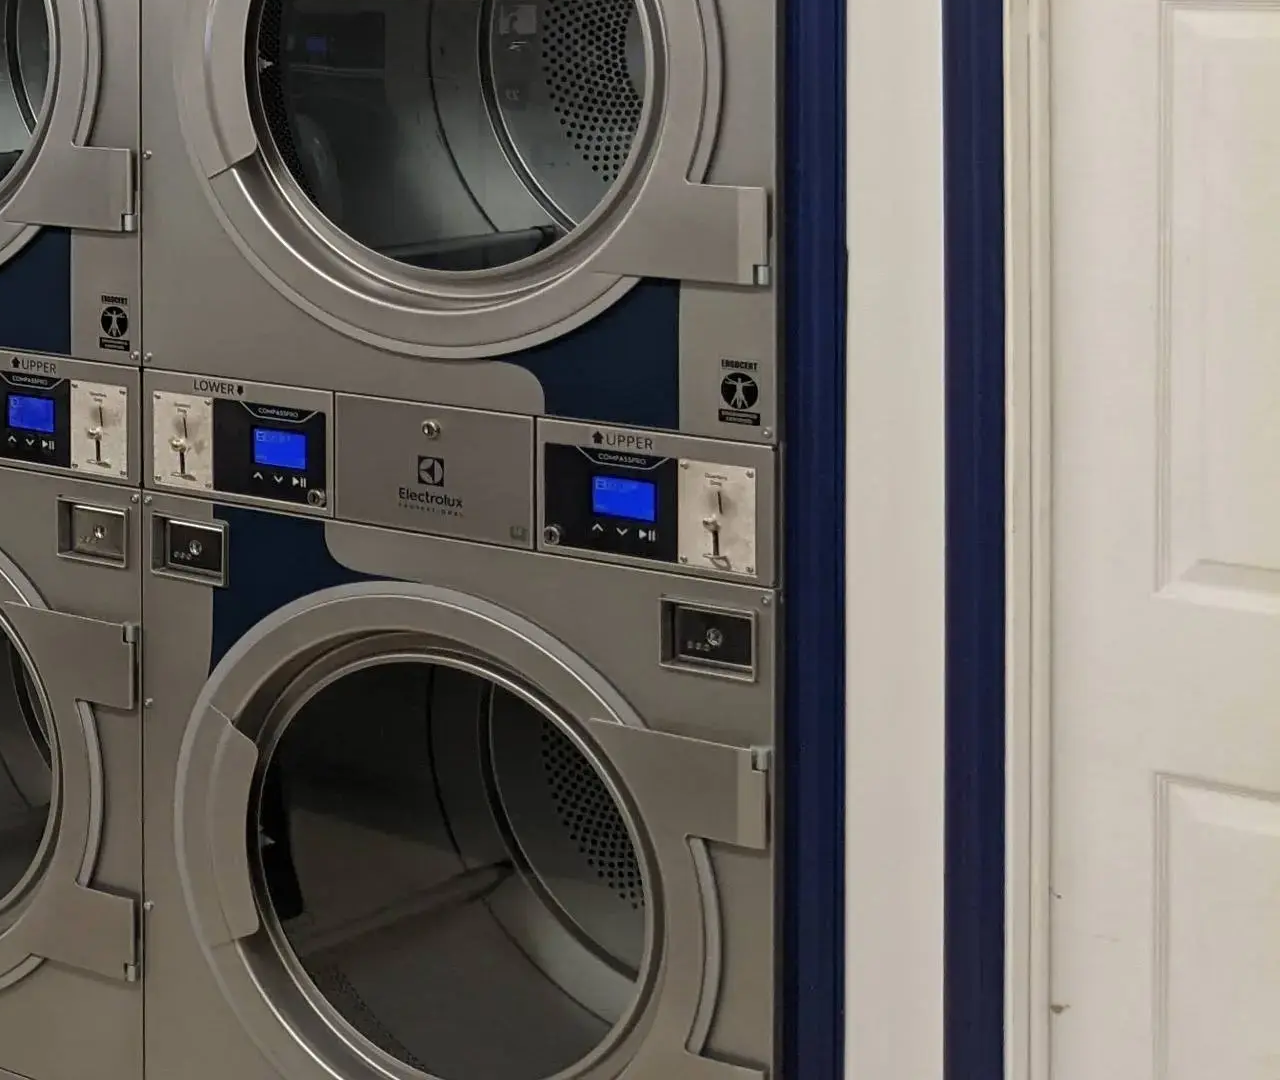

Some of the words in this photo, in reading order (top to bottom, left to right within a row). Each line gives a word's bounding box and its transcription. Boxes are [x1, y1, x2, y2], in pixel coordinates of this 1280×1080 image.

[21, 359, 57, 374] UPPER
[193, 379, 235, 395] LOWER
[606, 433, 653, 450] UPPER
[398, 487, 463, 508] Electrolux
